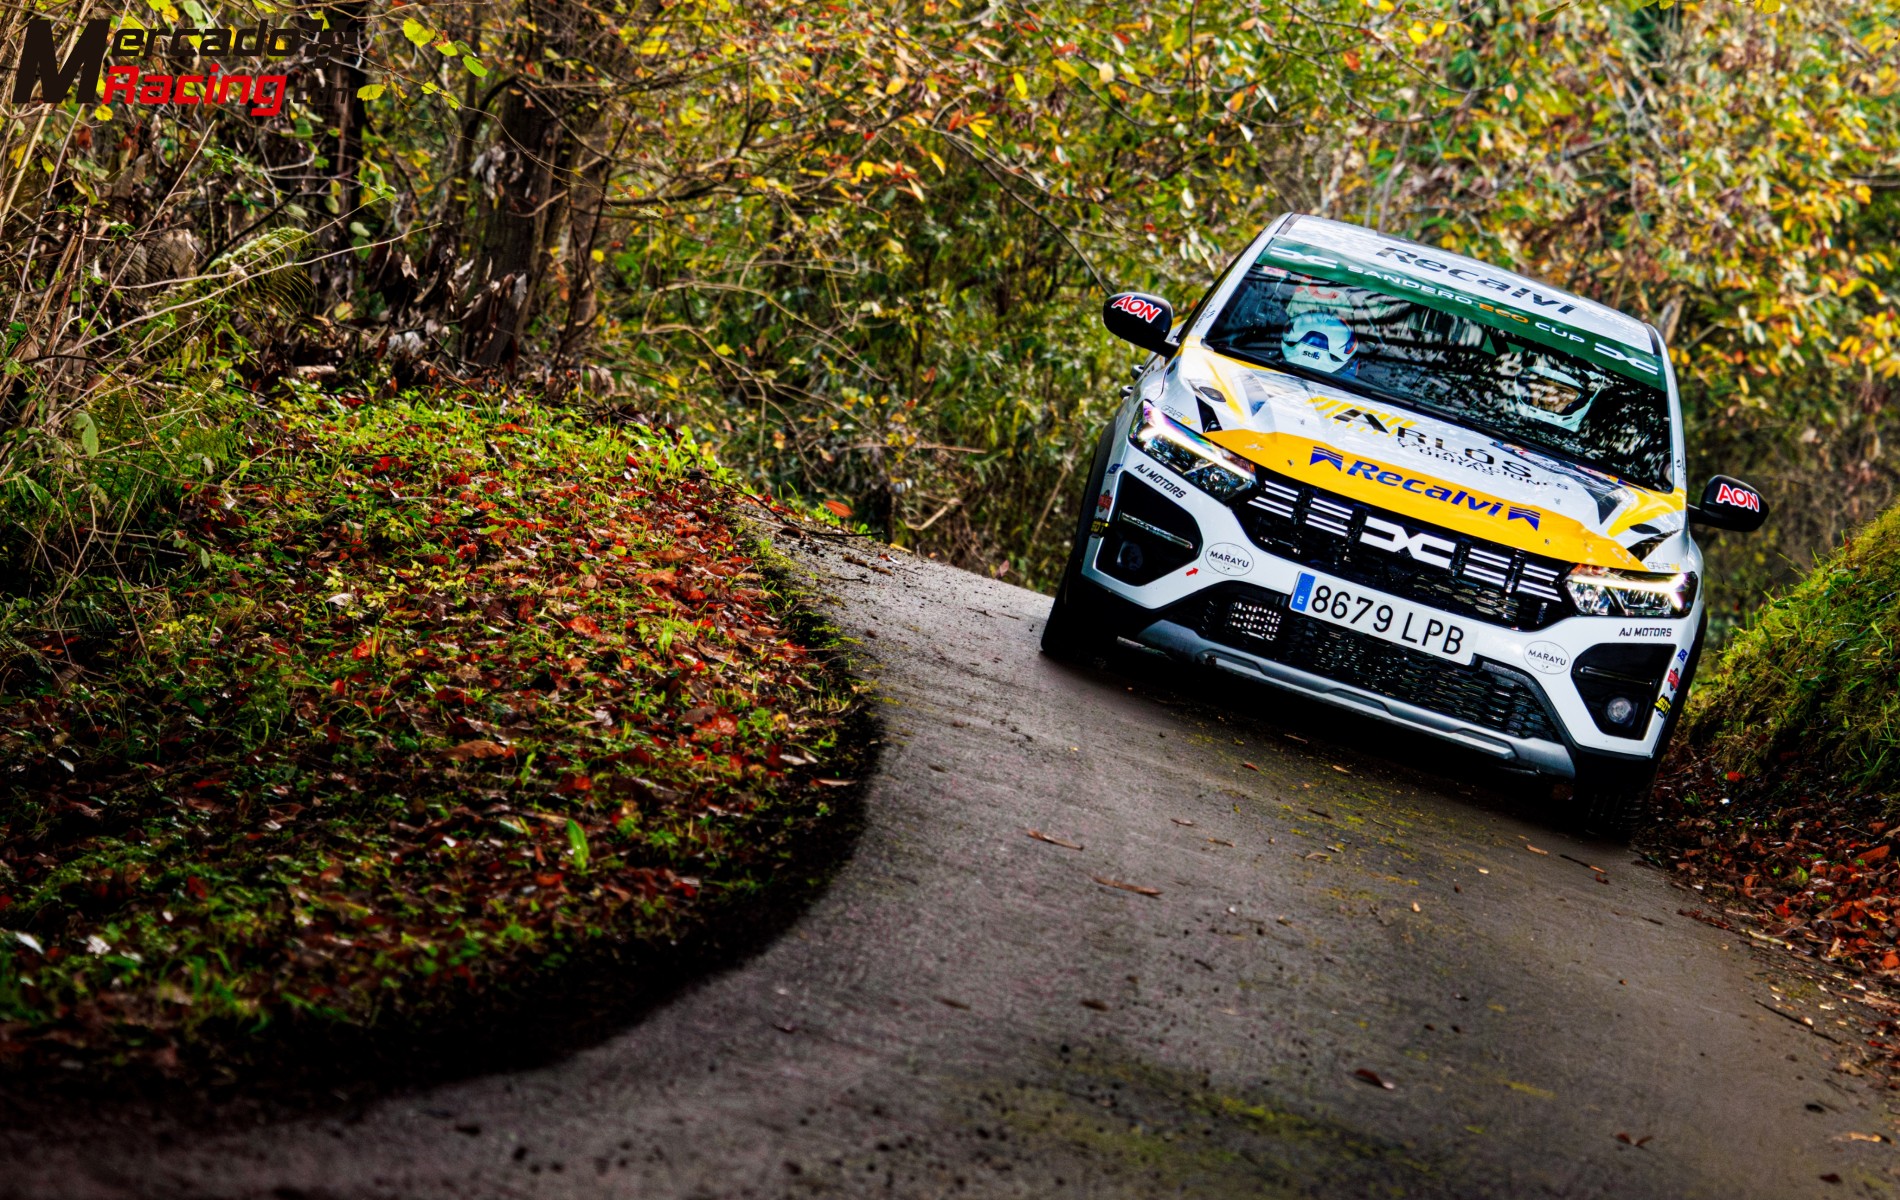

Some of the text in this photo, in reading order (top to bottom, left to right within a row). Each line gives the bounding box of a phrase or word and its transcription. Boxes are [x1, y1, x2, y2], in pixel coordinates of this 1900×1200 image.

[1376, 246, 1578, 315] Recalvi
[1112, 295, 1163, 323] AON
[1348, 265, 1473, 305] SANDERO
[1479, 302, 1529, 324] ECO
[1535, 321, 1585, 343] CUP
[1134, 463, 1150, 474] AJ
[1146, 470, 1187, 498] MOTORS
[1346, 460, 1504, 517] Recalvi
[1716, 484, 1760, 512] AON
[1210, 550, 1250, 568] MARAYU
[1296, 595, 1305, 605] E
[1311, 585, 1464, 655] 8679 LPB
[1619, 627, 1673, 637] AJ MOTORS
[1528, 649, 1567, 666] MARAYU
